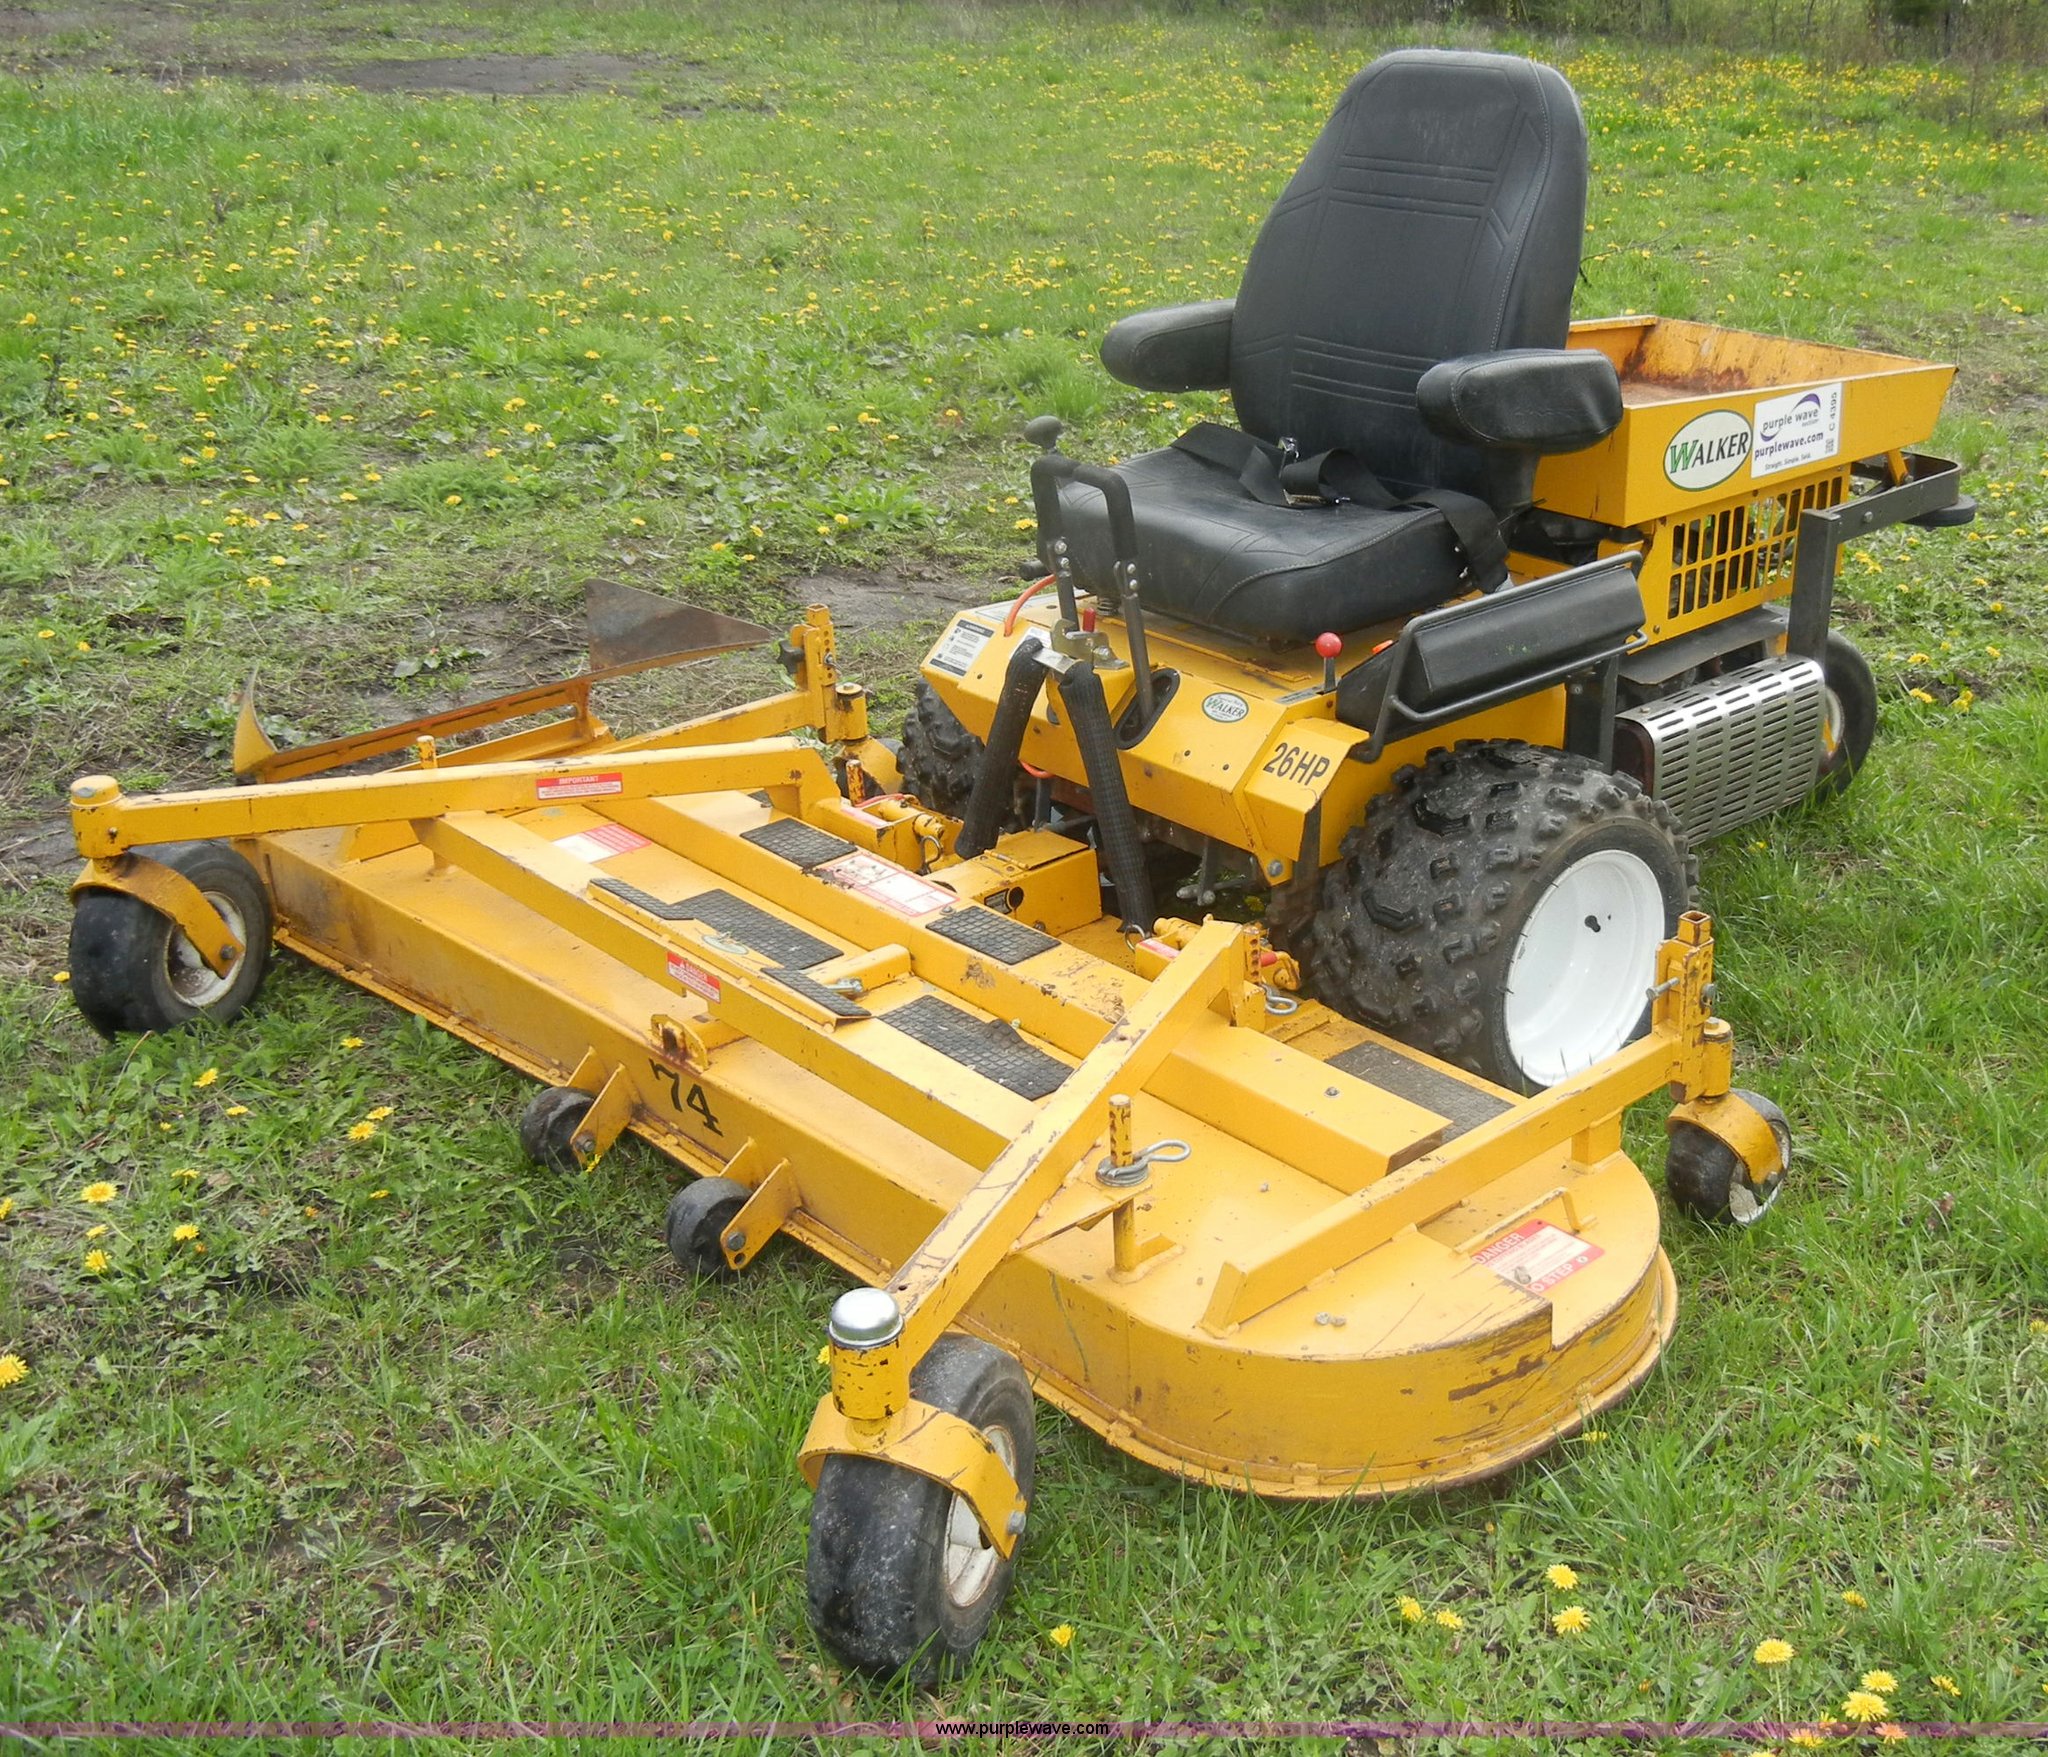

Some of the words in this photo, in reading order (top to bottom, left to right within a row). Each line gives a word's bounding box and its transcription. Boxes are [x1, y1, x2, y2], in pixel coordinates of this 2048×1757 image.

[1763, 414, 1793, 433] purple
[1795, 408, 1819, 422] wave
[1670, 431, 1749, 474] WALKER
[1754, 432, 1824, 461] purplewave.com
[1206, 698, 1245, 717] WALKER
[649, 1057, 724, 1137] 74
[1471, 1232, 1525, 1265] DANGER
[1543, 1263, 1575, 1287] STEP
